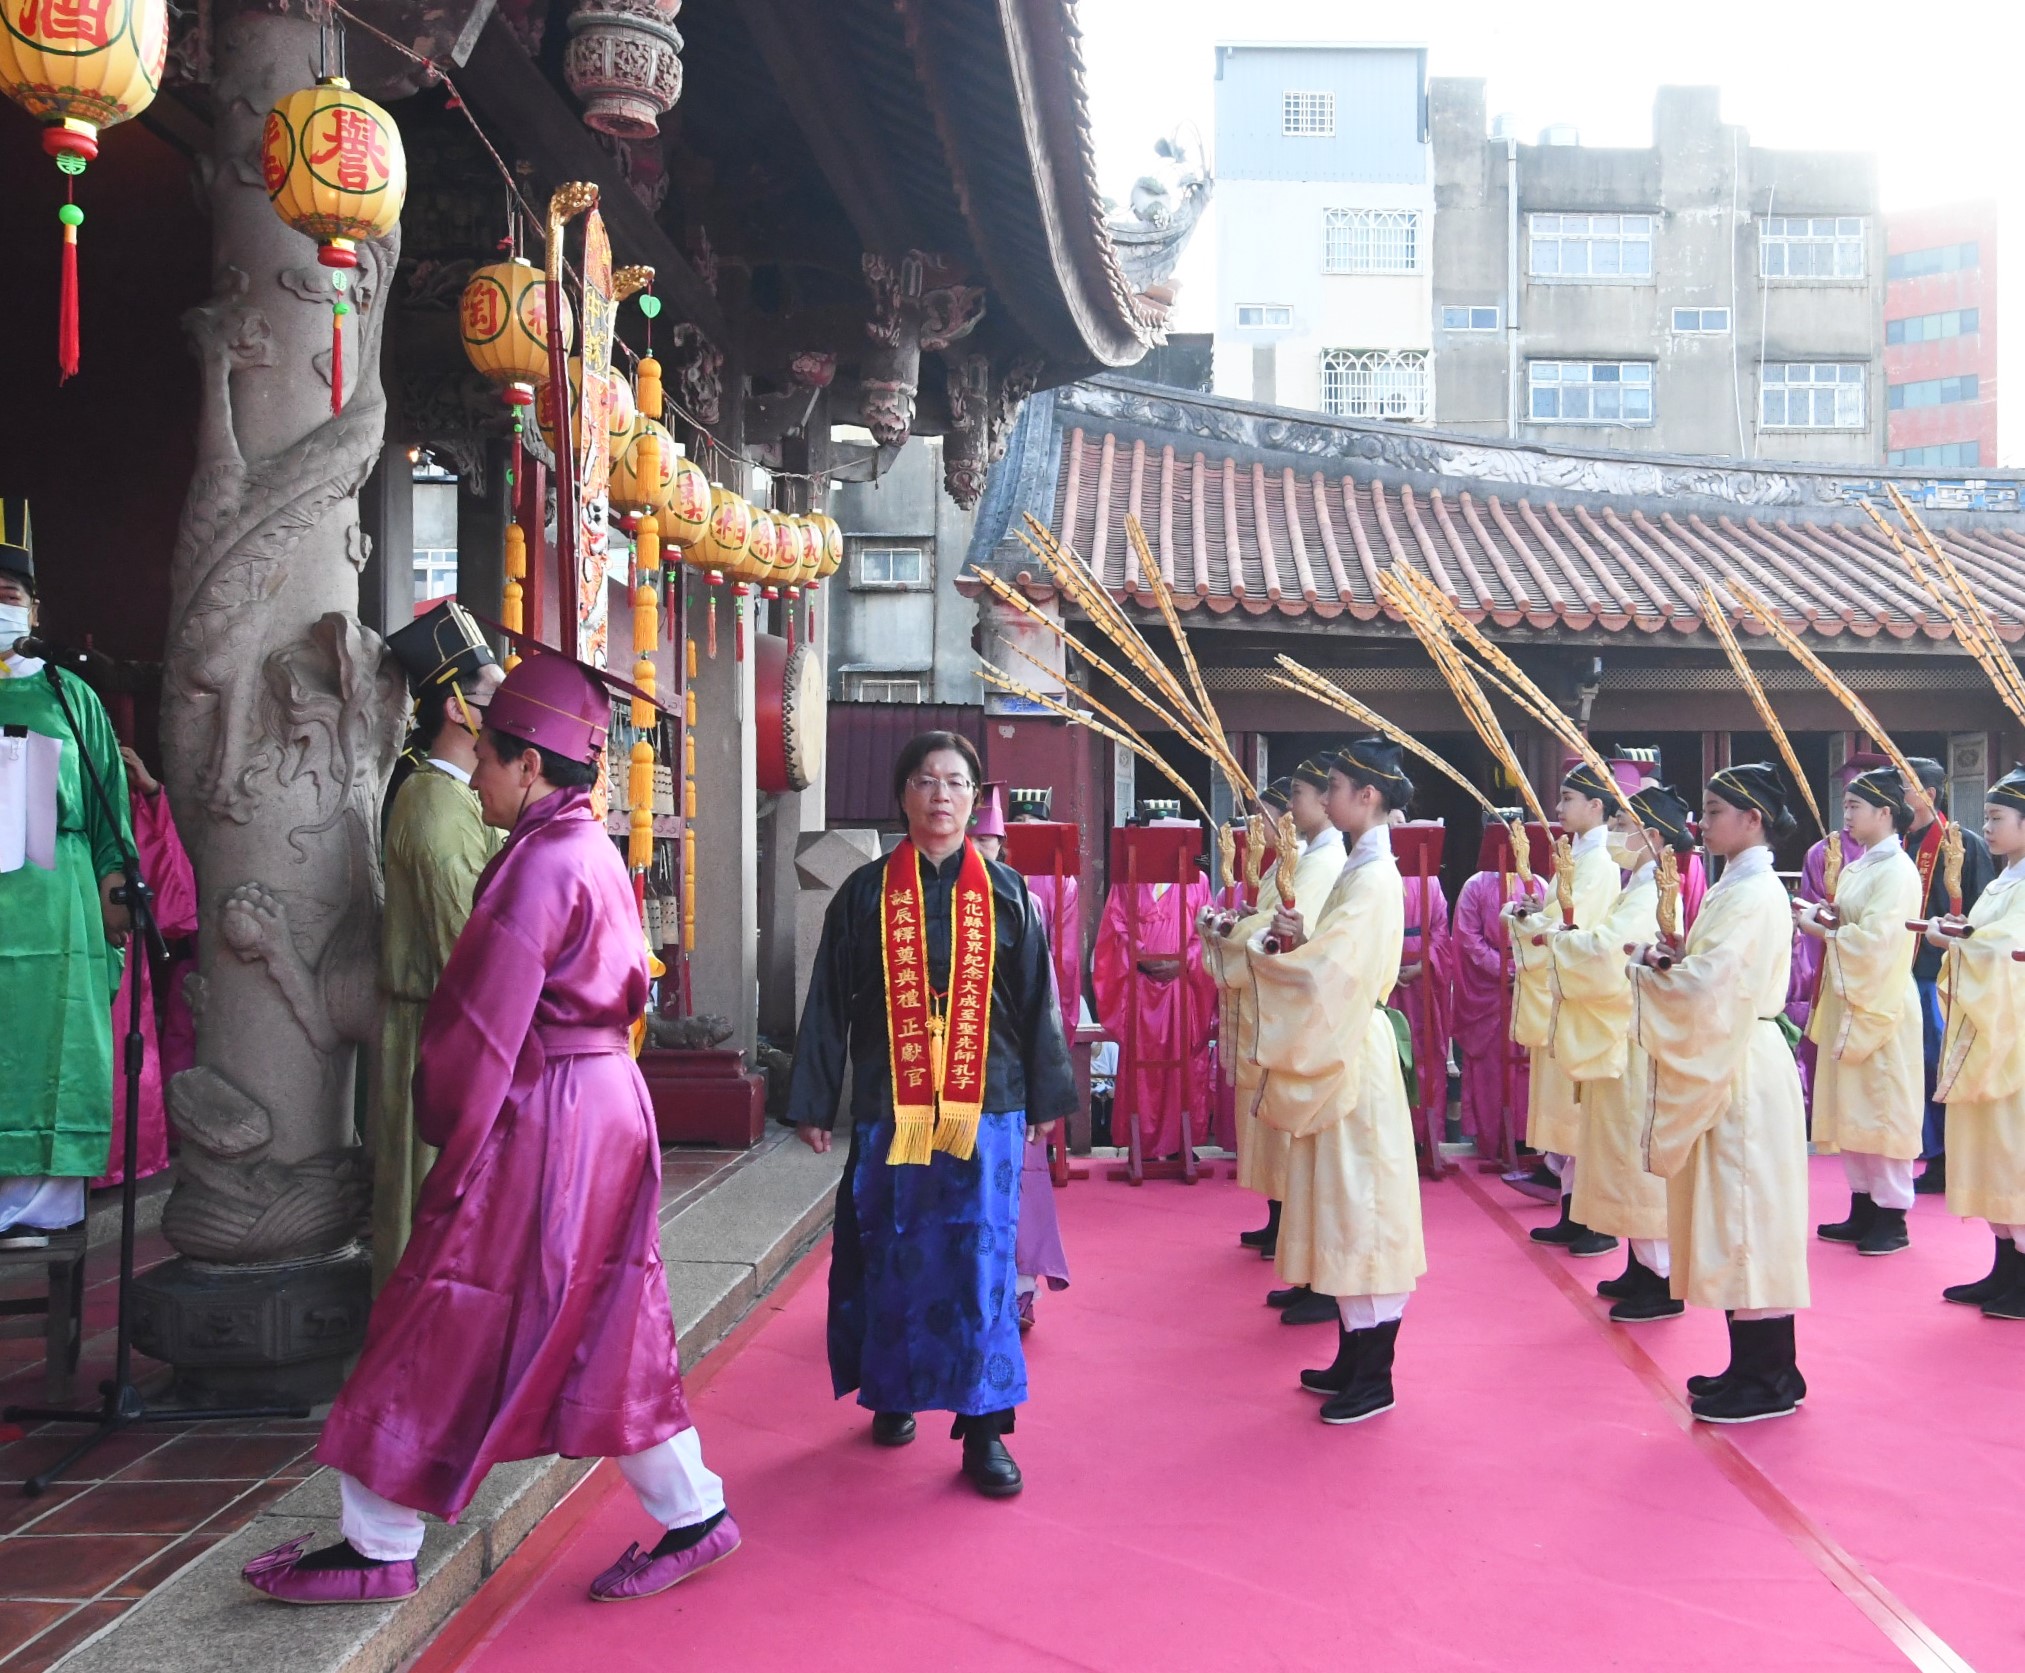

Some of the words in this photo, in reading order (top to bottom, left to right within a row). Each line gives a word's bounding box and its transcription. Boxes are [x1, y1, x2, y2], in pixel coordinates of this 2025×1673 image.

[309, 109, 390, 191] 譽
[951, 889, 987, 1090] 彰化縣各界紀念大成至聖先師孔子
